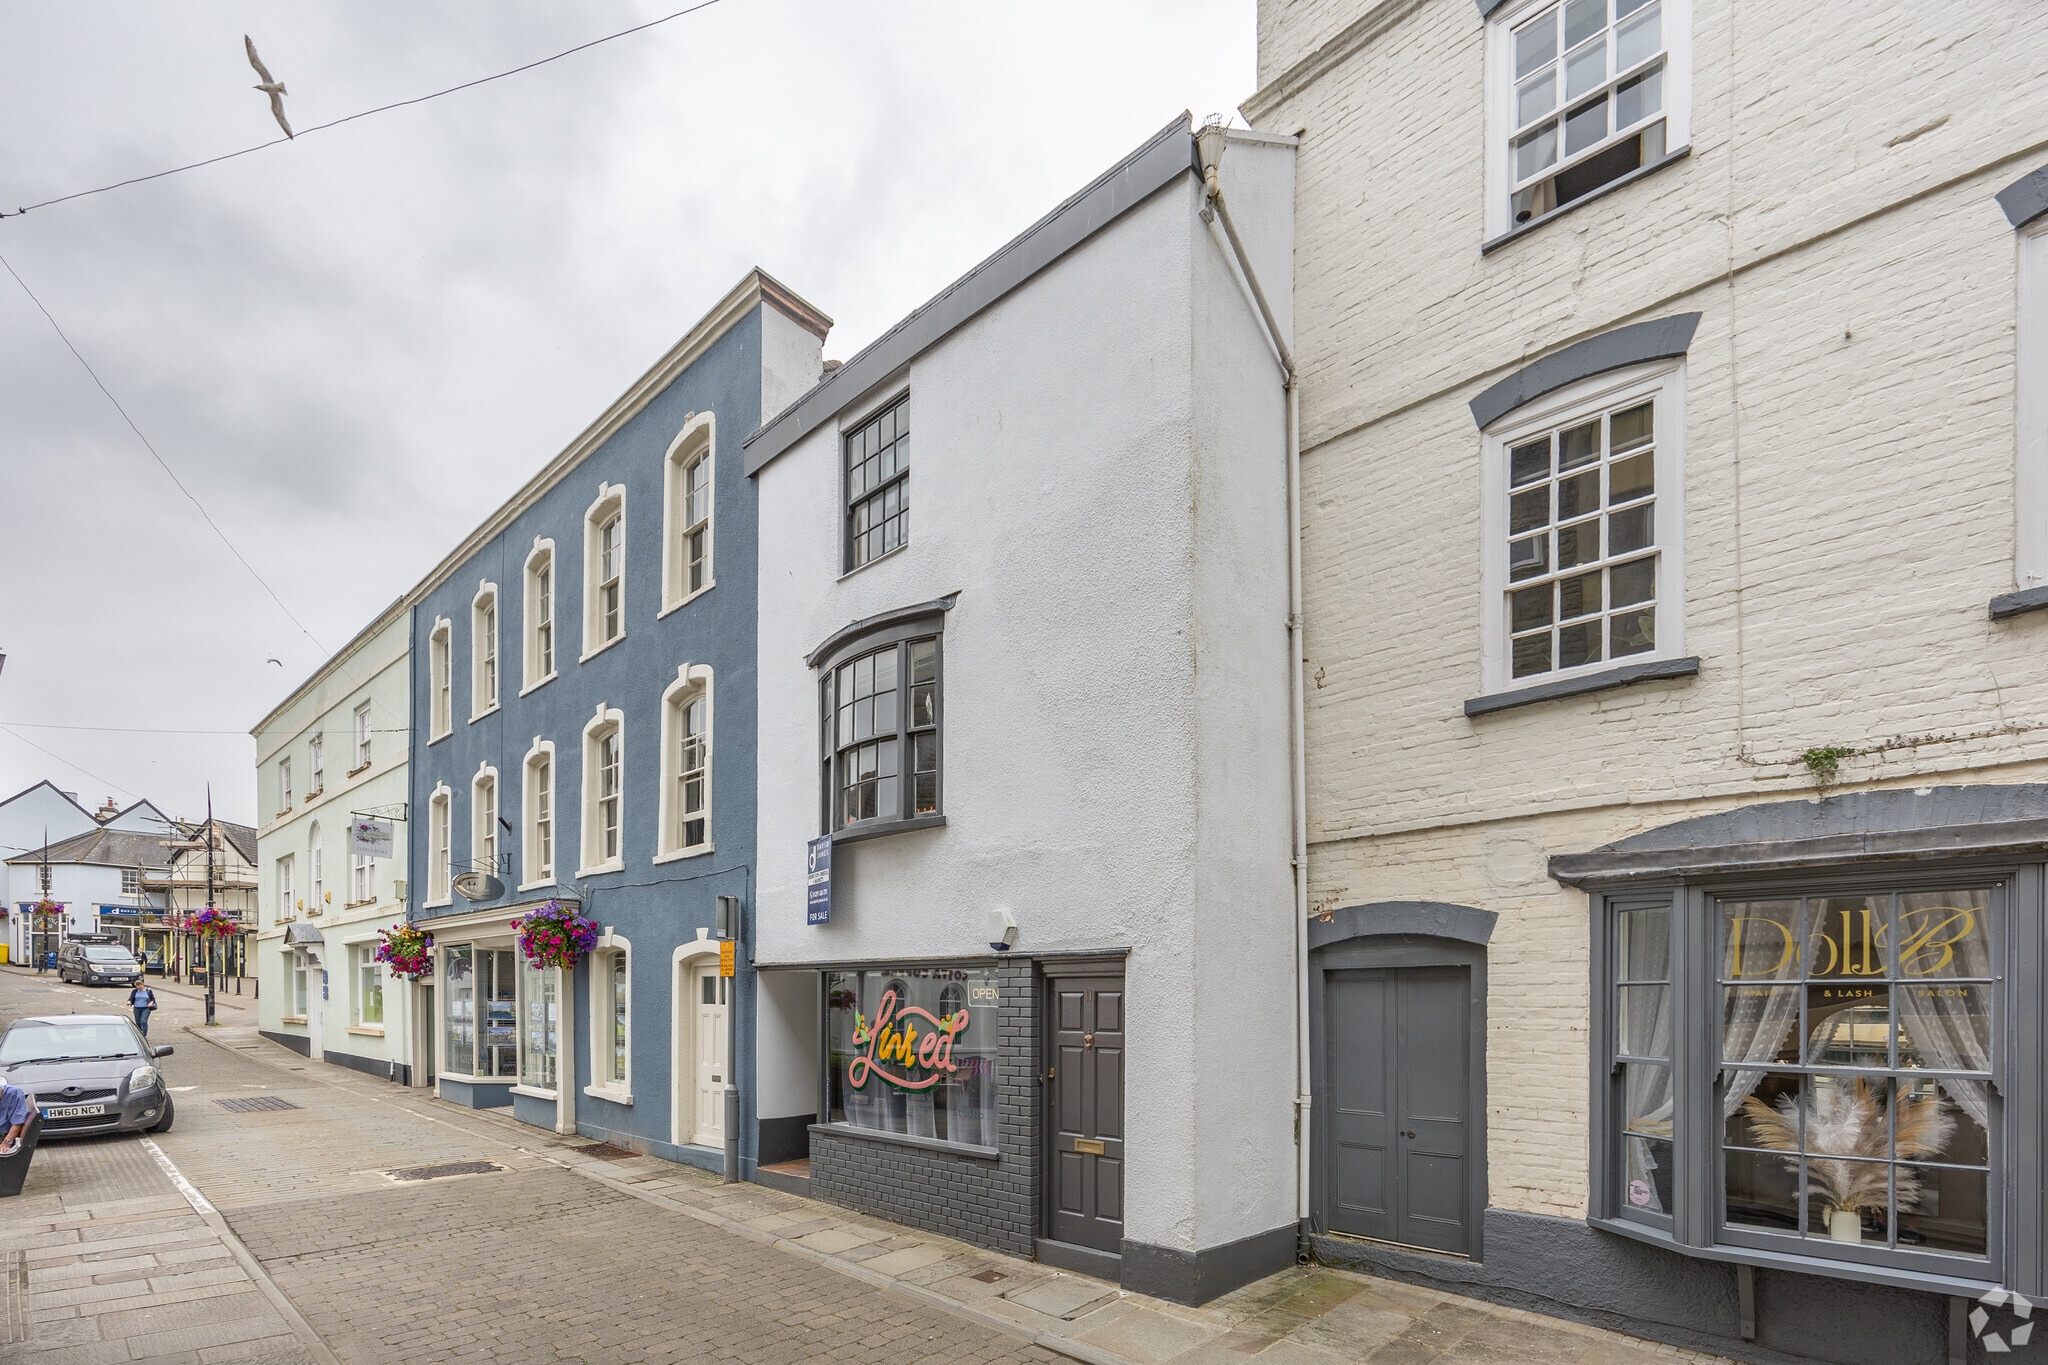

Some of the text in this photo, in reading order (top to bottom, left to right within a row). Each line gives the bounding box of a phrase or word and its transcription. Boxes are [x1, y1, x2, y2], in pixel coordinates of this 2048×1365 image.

[810, 911, 828, 921] FOR SALE
[972, 988, 999, 999] OPEN
[1823, 989, 1832, 998] &
[1837, 989, 1874, 998] LASH
[1917, 989, 1968, 998] SALON
[849, 989, 970, 1092] Linked
[50, 1106, 102, 1117] HW60 NCV
[952, 1107, 984, 1120] Studio
